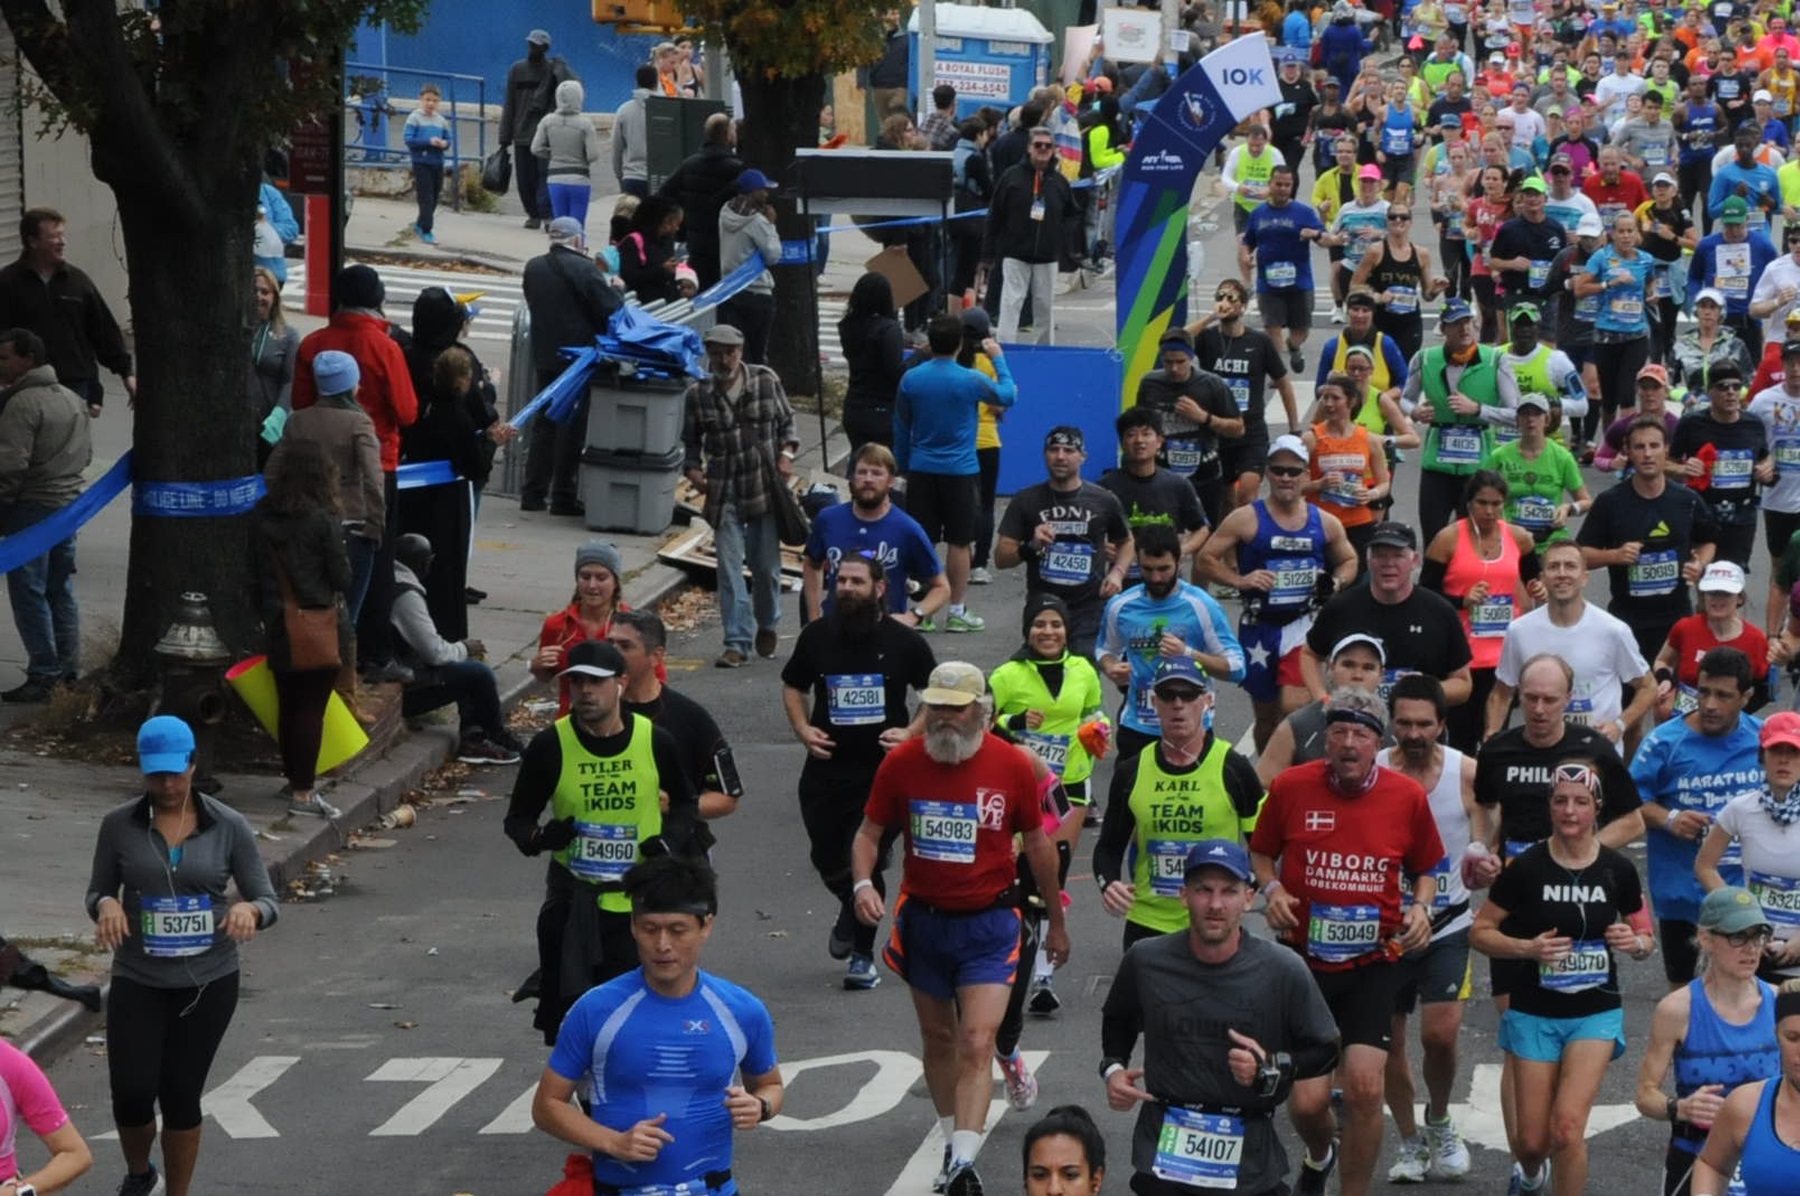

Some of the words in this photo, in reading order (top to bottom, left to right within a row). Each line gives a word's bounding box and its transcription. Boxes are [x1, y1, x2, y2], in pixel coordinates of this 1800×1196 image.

[1222, 68, 1264, 86] 10K
[1039, 506, 1097, 523] FDNY
[1053, 556, 1088, 572] 42458
[843, 690, 879, 706] 42581
[578, 760, 633, 775] TYLER
[1507, 766, 1551, 783] PHIL
[580, 782, 636, 797] TEAM
[1153, 780, 1201, 792] KARL
[590, 797, 636, 811] KIDS
[1150, 804, 1204, 819] TEAM
[926, 818, 973, 841] 54983
[1158, 820, 1204, 834] KIDS
[585, 840, 634, 859] 54960
[1306, 848, 1391, 872] VIBORG
[1305, 865, 1386, 883] DANMARKS
[1543, 885, 1607, 903] NINA
[163, 915, 206, 934] 53751
[1327, 923, 1376, 942] 53049
[1185, 1134, 1237, 1160] 54107
